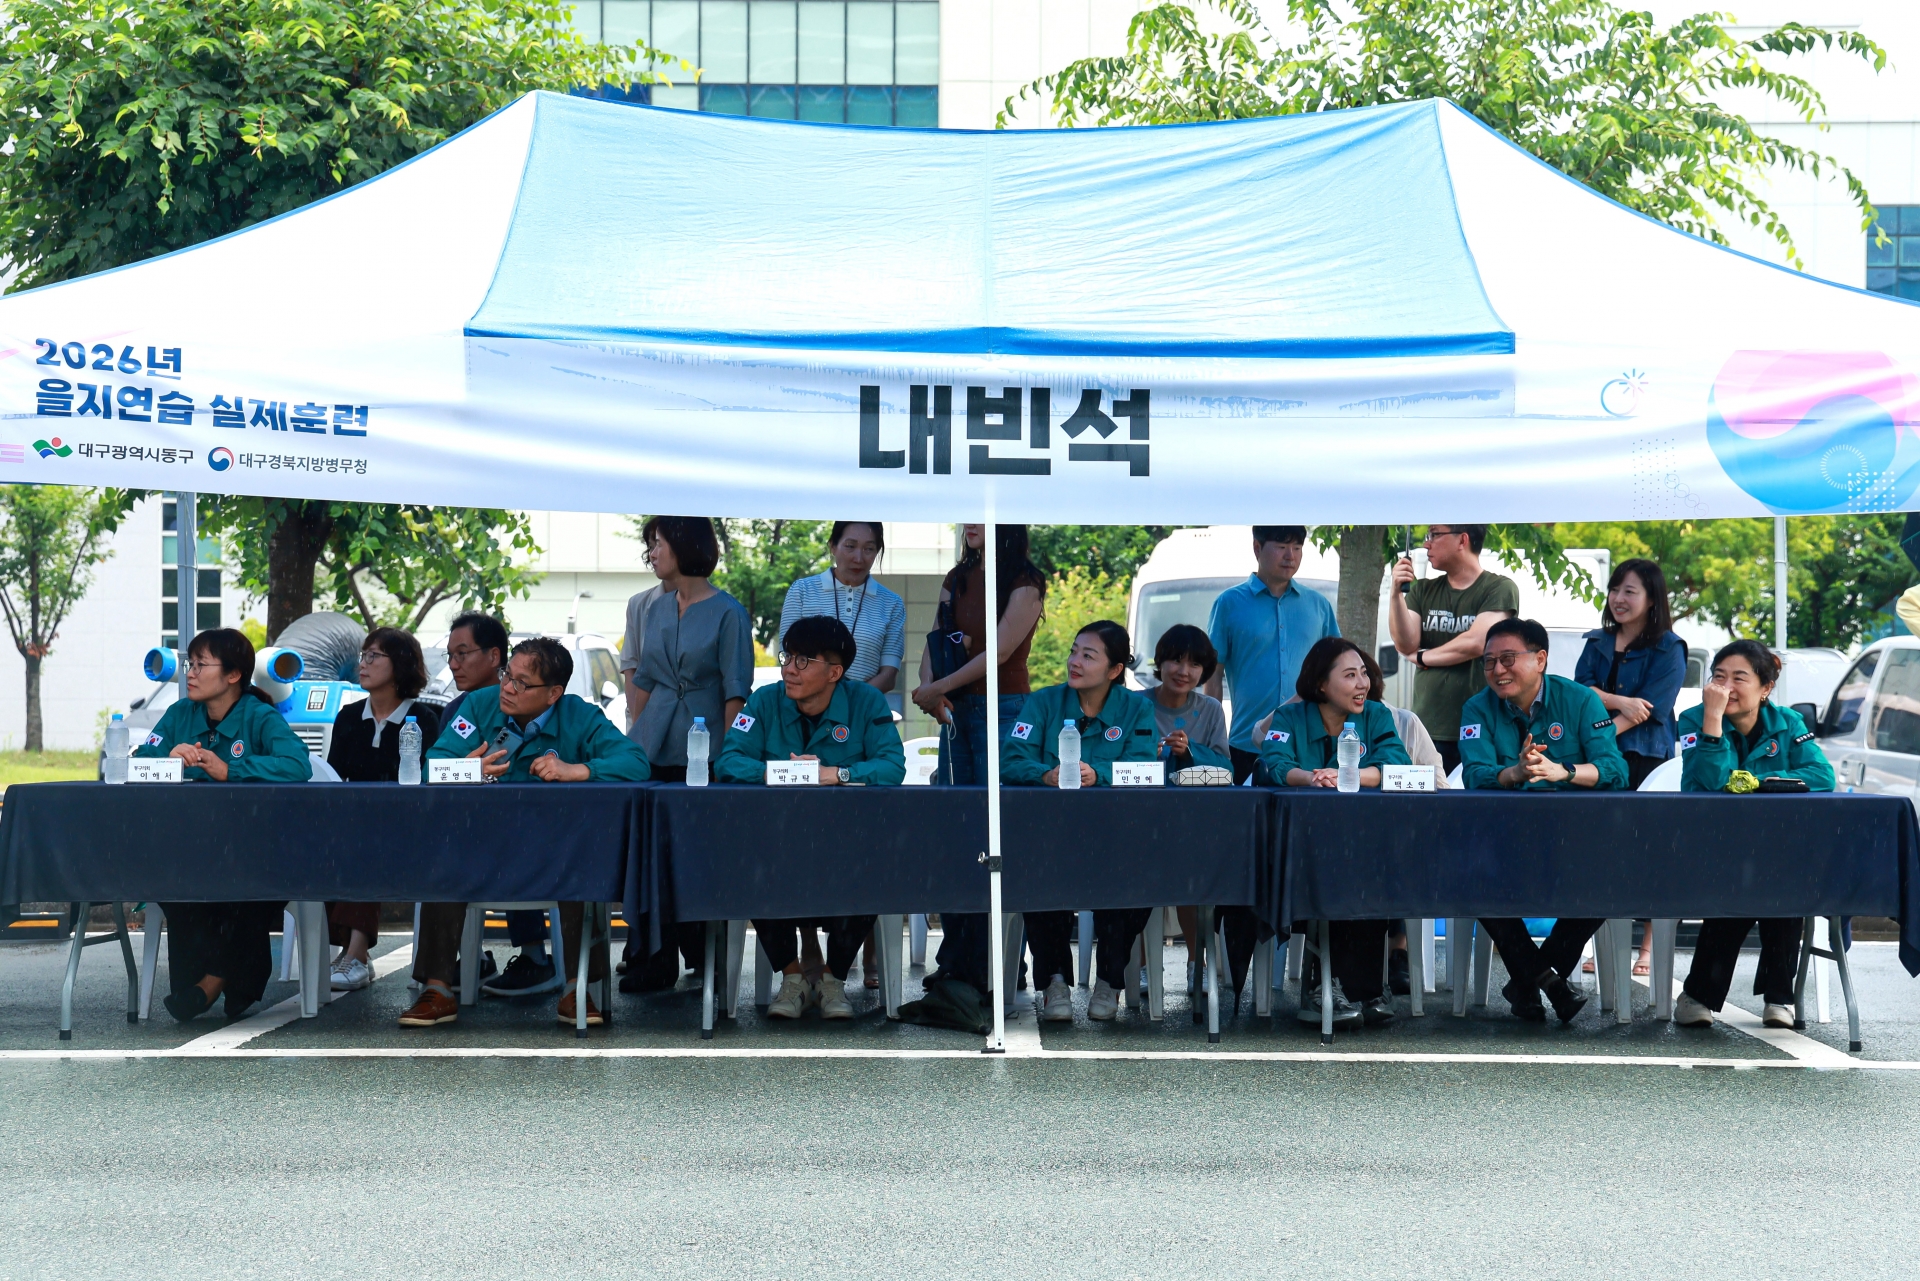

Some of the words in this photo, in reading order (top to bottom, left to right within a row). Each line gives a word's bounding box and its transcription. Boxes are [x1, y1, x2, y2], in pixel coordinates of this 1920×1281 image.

[36, 338, 182, 380] 2026년
[36, 378, 195, 425] 을지연습
[208, 394, 369, 437] 실제훈련
[859, 384, 1151, 477] 내빈석
[78, 442, 194, 464] 대구광역시동구
[239, 452, 368, 475] 대구경북지방병무청
